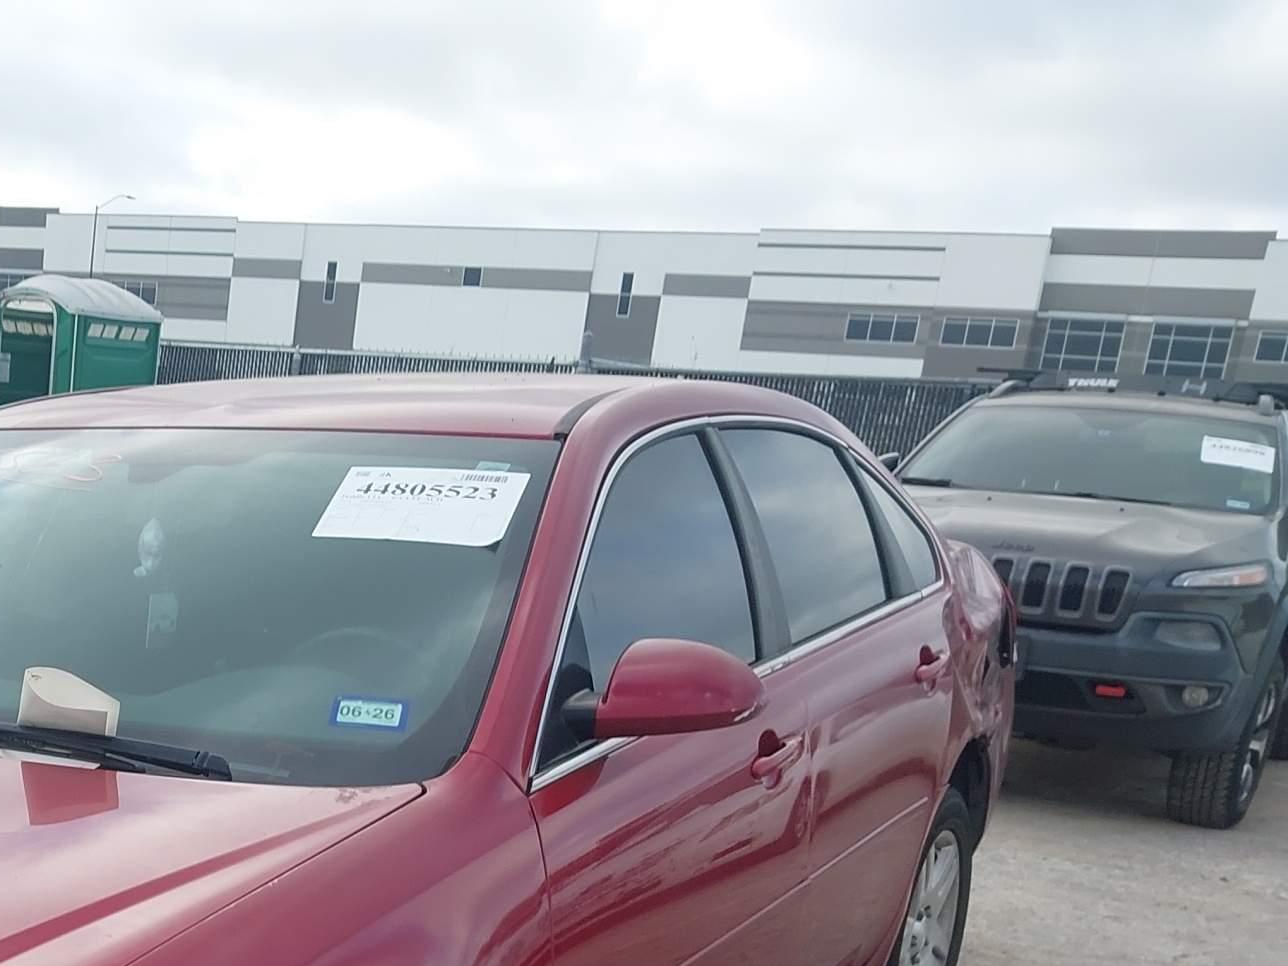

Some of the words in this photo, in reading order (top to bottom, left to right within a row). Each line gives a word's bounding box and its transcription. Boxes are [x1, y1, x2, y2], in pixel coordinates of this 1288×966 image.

[355, 482, 499, 501] 44805523
[339, 705, 362, 718] 06
[372, 708, 395, 720] 26
